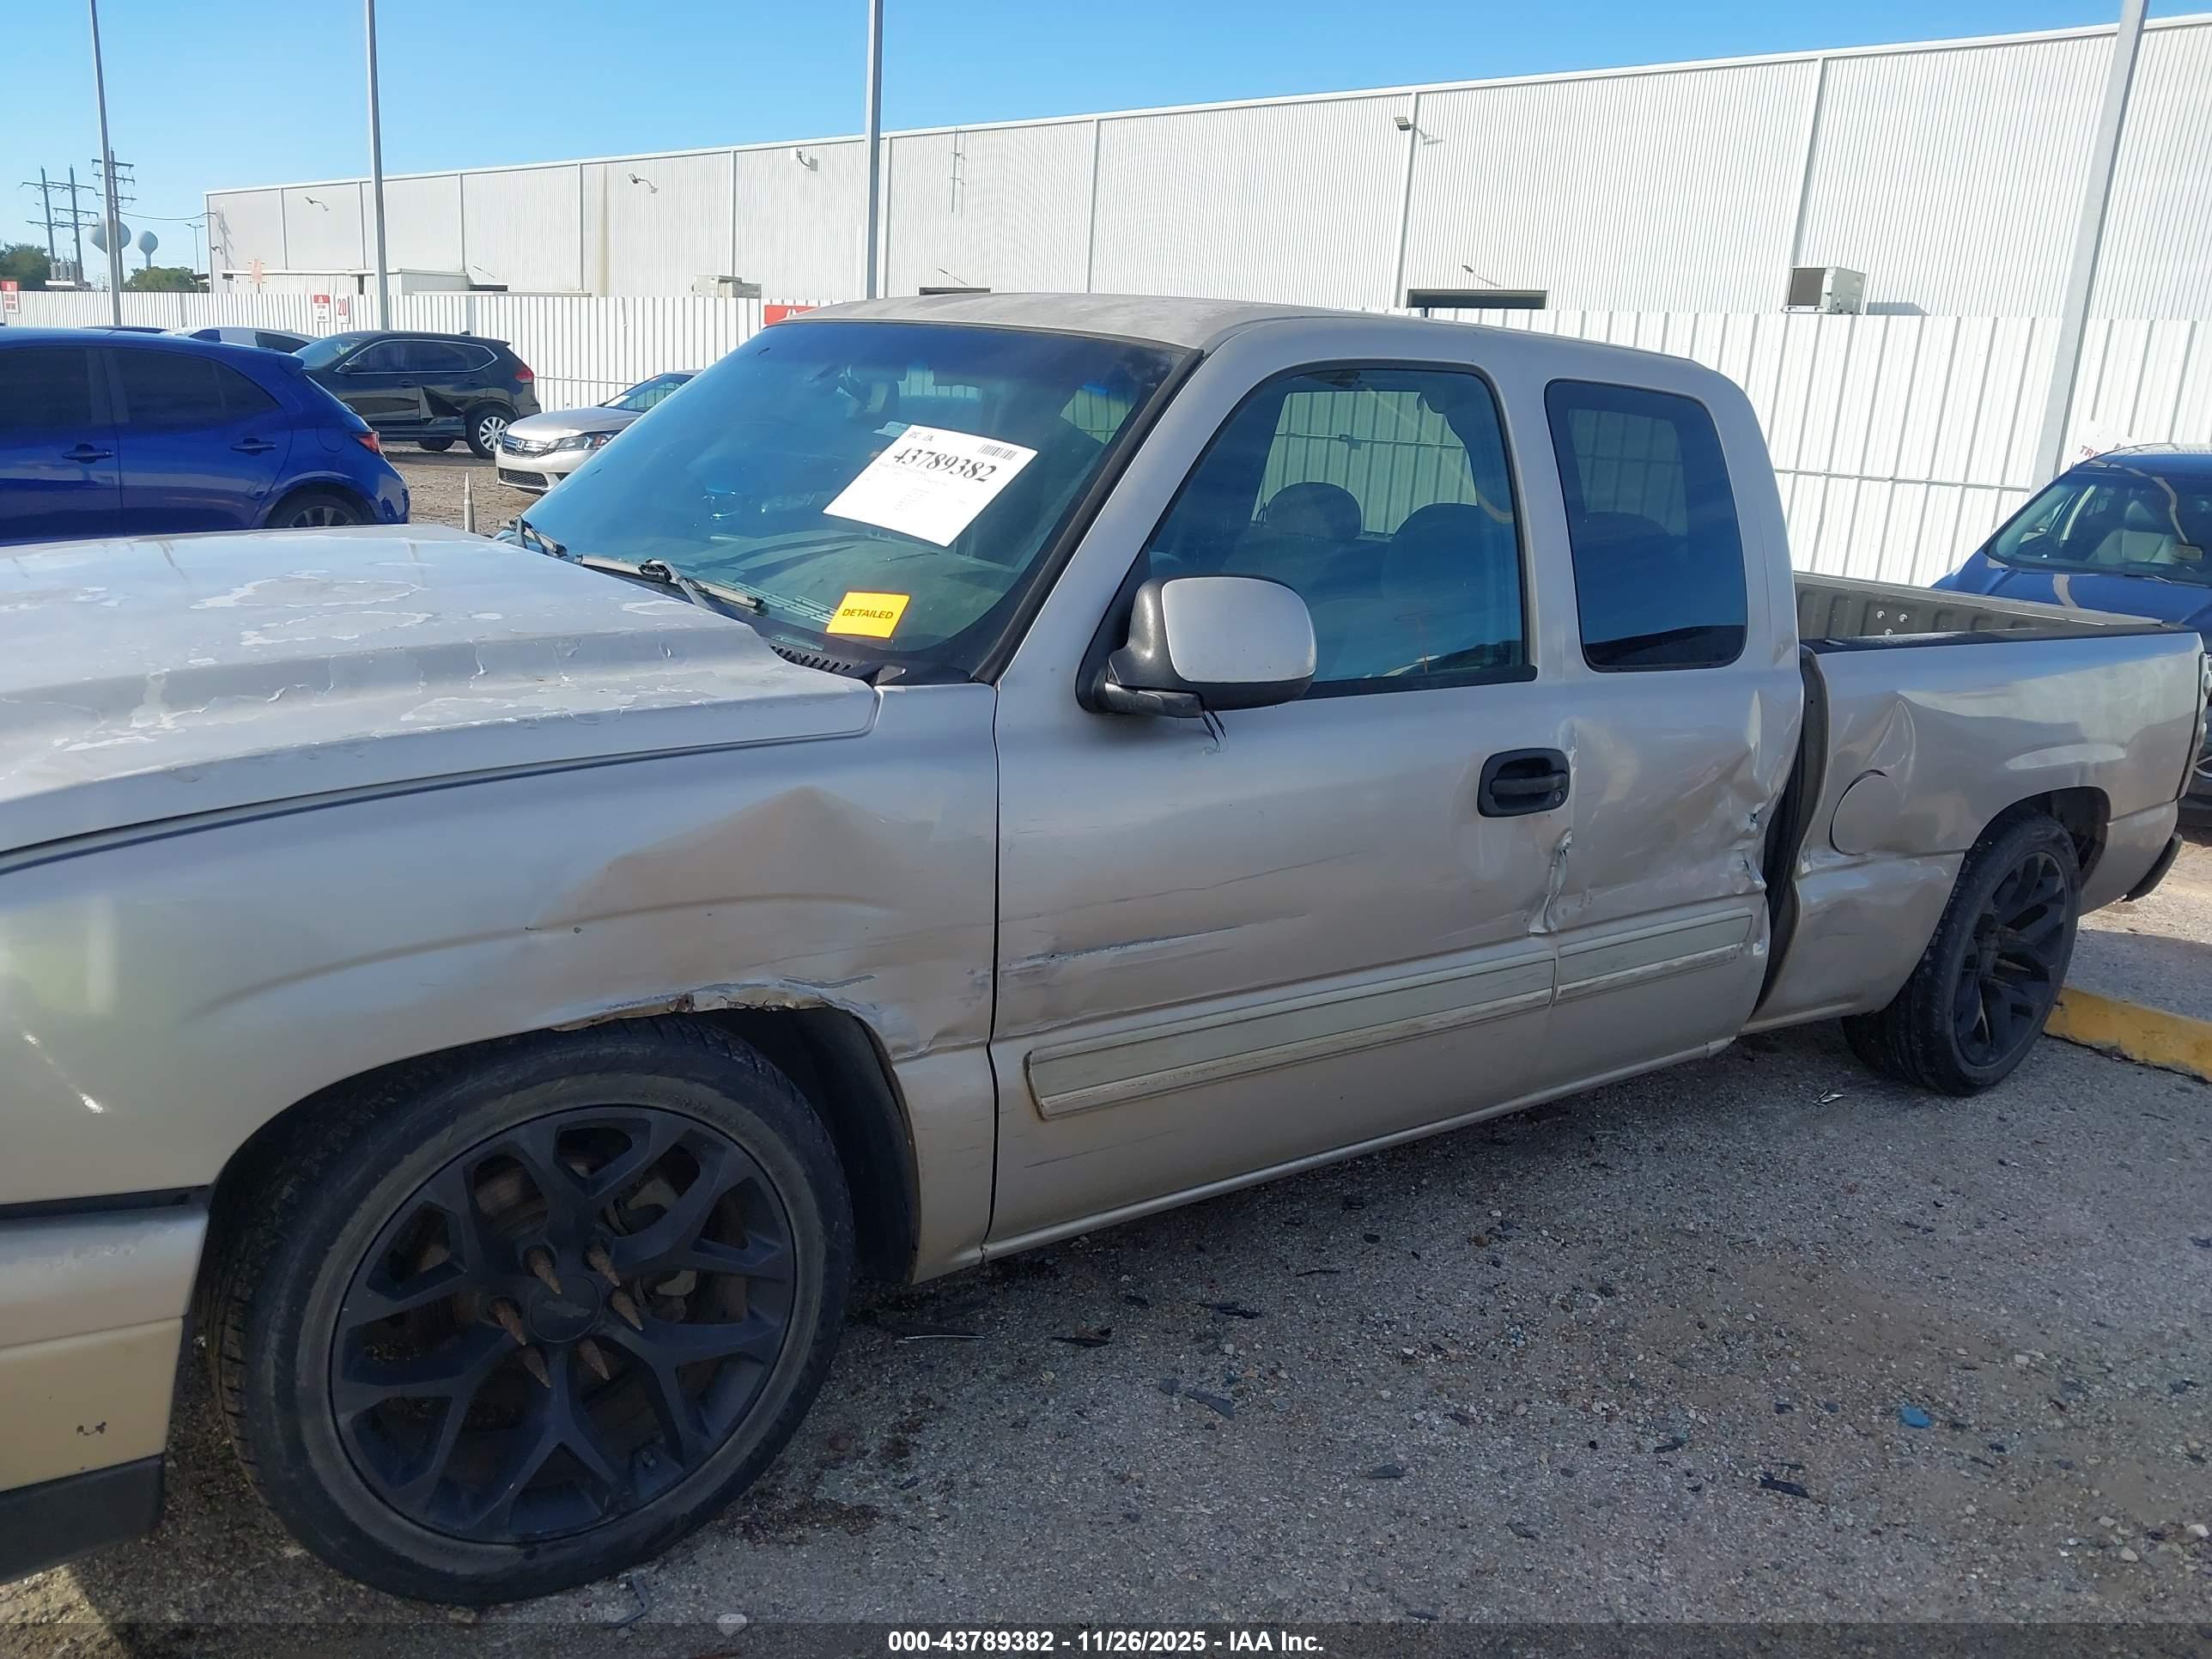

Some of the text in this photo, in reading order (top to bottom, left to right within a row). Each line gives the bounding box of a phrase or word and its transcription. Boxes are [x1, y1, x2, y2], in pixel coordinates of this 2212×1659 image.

[337, 298, 347, 316] 20
[893, 447, 997, 483] 43789382
[842, 608, 894, 619] DETAILED
